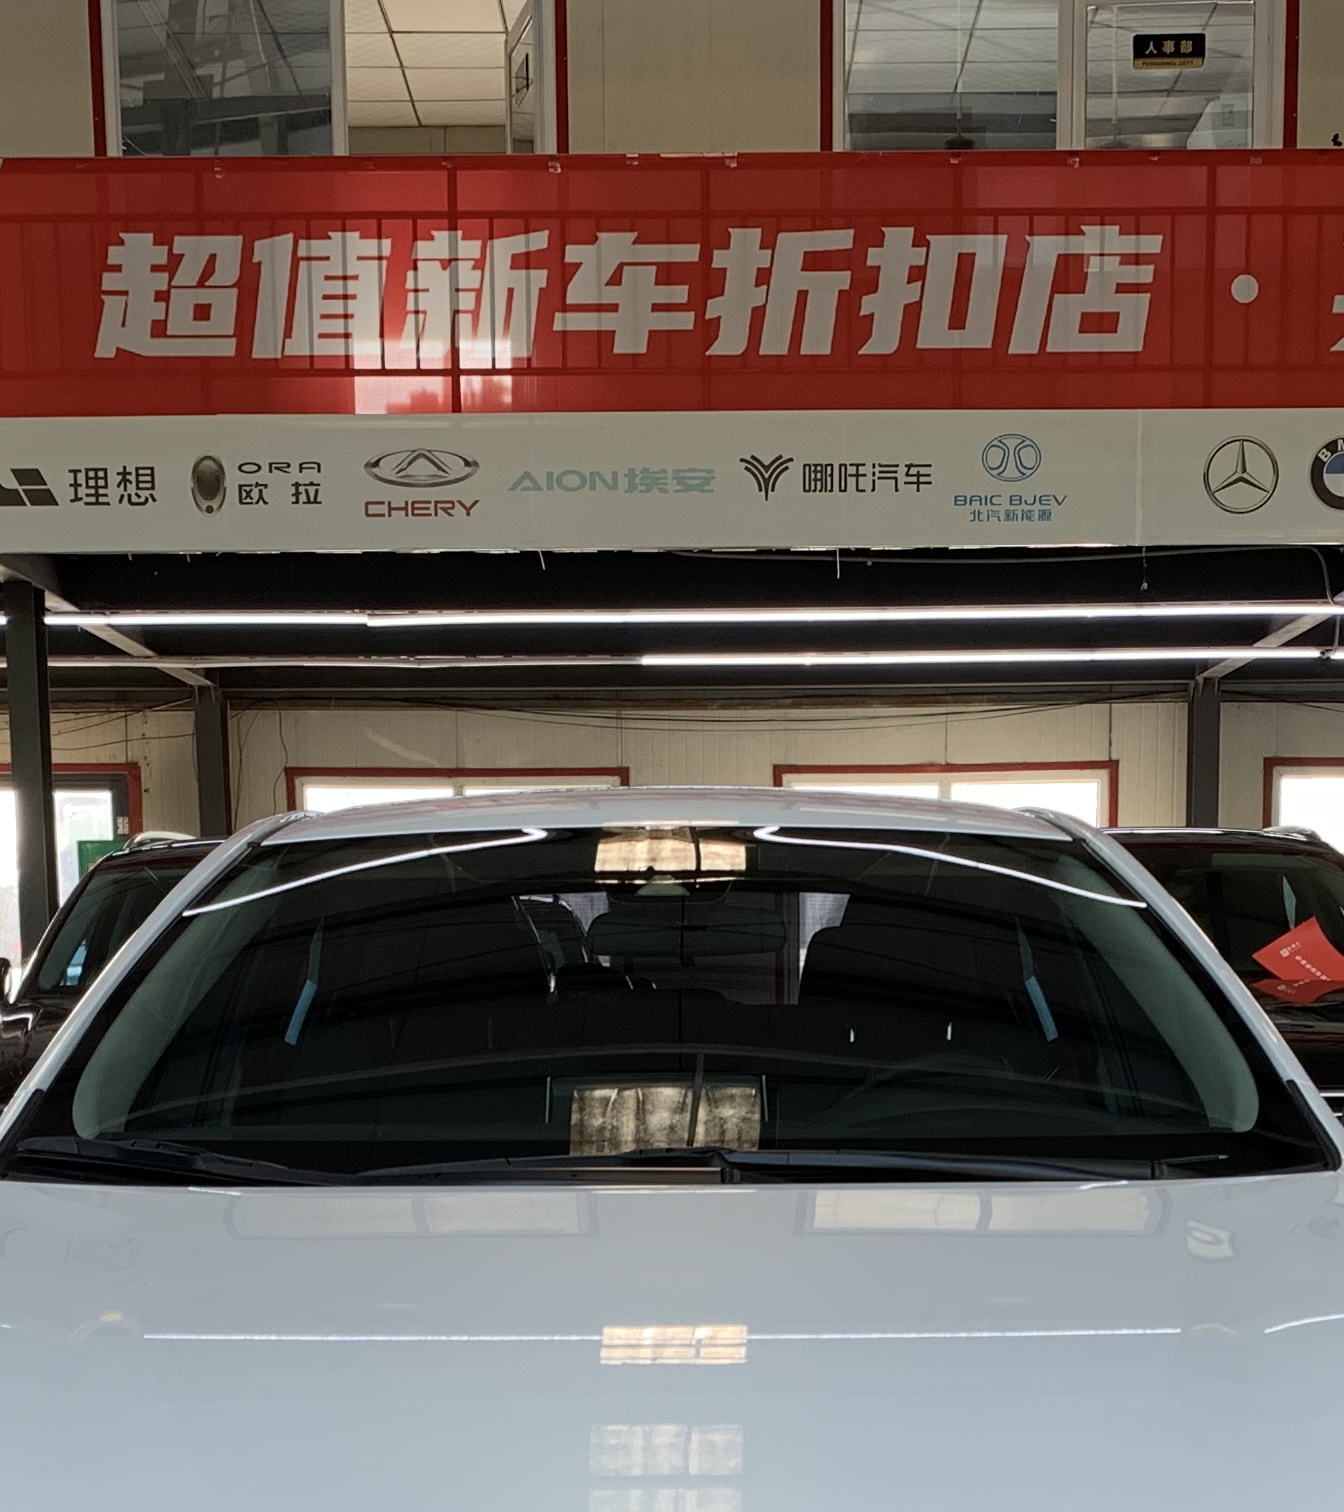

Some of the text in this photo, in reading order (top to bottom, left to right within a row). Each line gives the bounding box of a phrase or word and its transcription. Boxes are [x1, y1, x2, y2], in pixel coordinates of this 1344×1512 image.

[1144, 40, 1193, 55] 人事部
[93, 224, 1163, 360] 超值新车折扣店
[237, 461, 322, 475] ORA
[68, 465, 157, 507] 理想
[802, 462, 933, 493] 哪吒汽车
[237, 480, 323, 506] 欧拉
[953, 494, 1068, 507] BAIC BJEV
[364, 500, 481, 518] CHERY
[968, 508, 1053, 523] 北汽新能源
